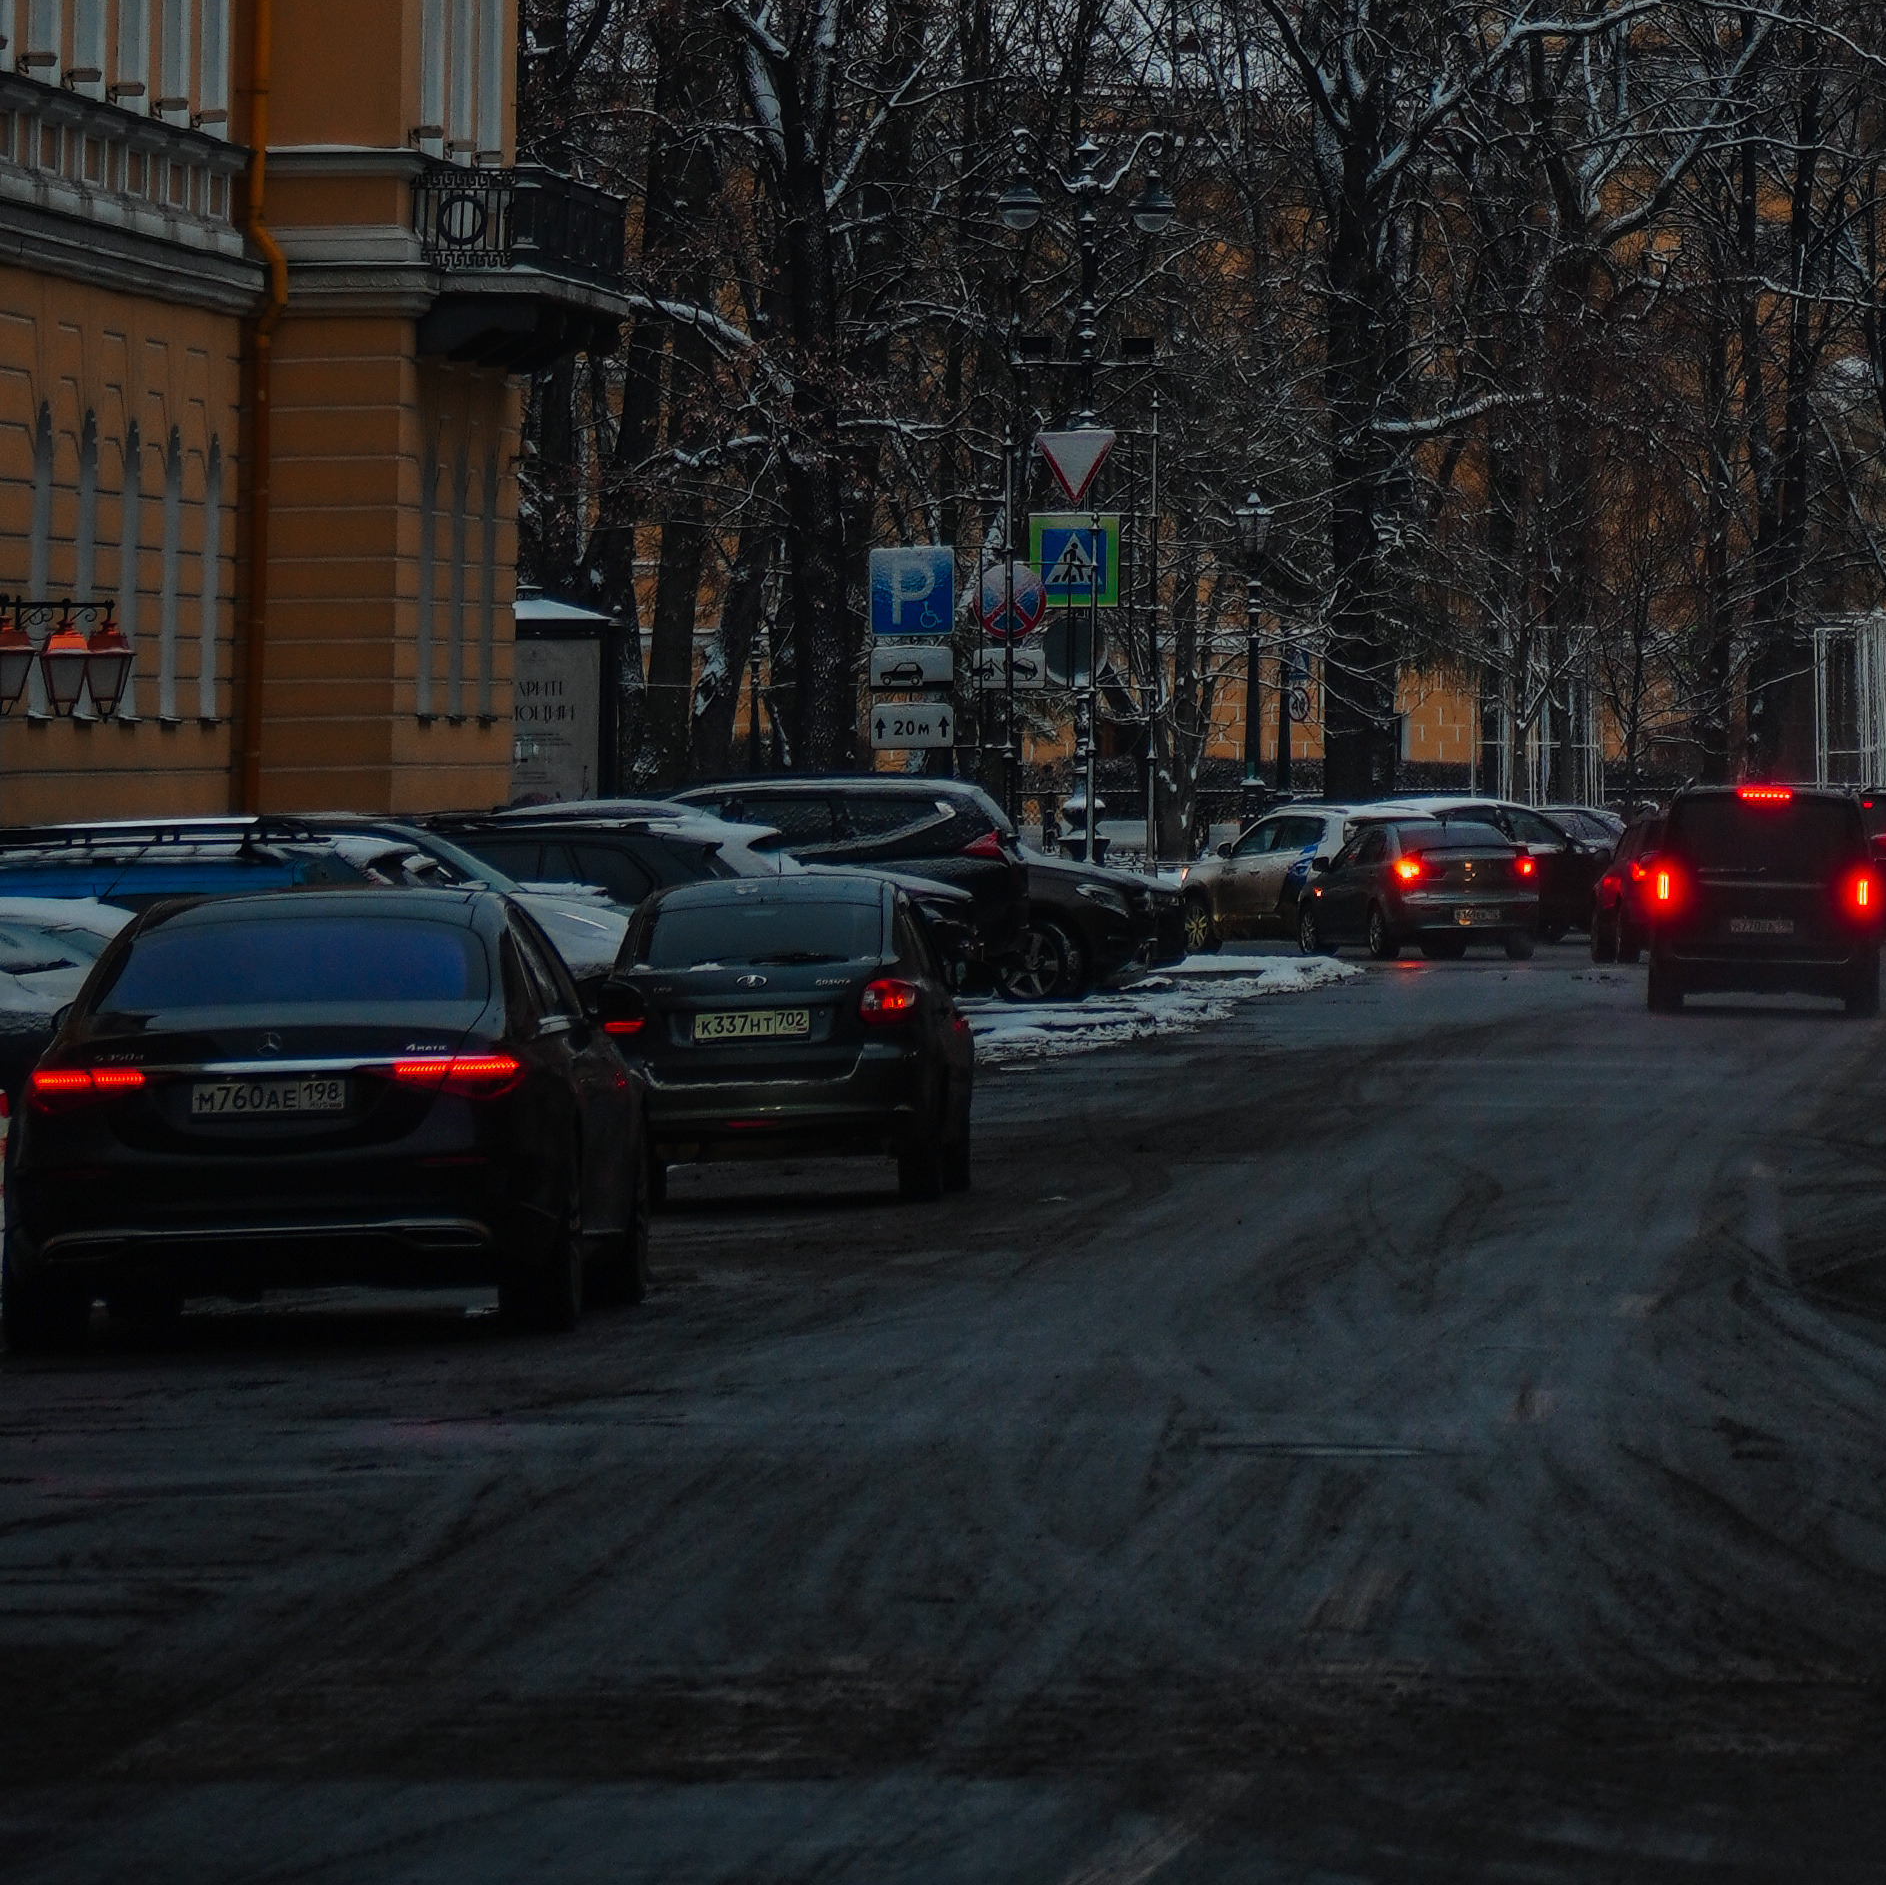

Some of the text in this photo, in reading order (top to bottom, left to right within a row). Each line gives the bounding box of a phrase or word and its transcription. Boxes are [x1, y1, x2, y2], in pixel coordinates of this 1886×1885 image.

[892, 562, 935, 625] P
[701, 1012, 805, 1035] К337НТ 702
[198, 1082, 340, 1111] М760АЕ 198
